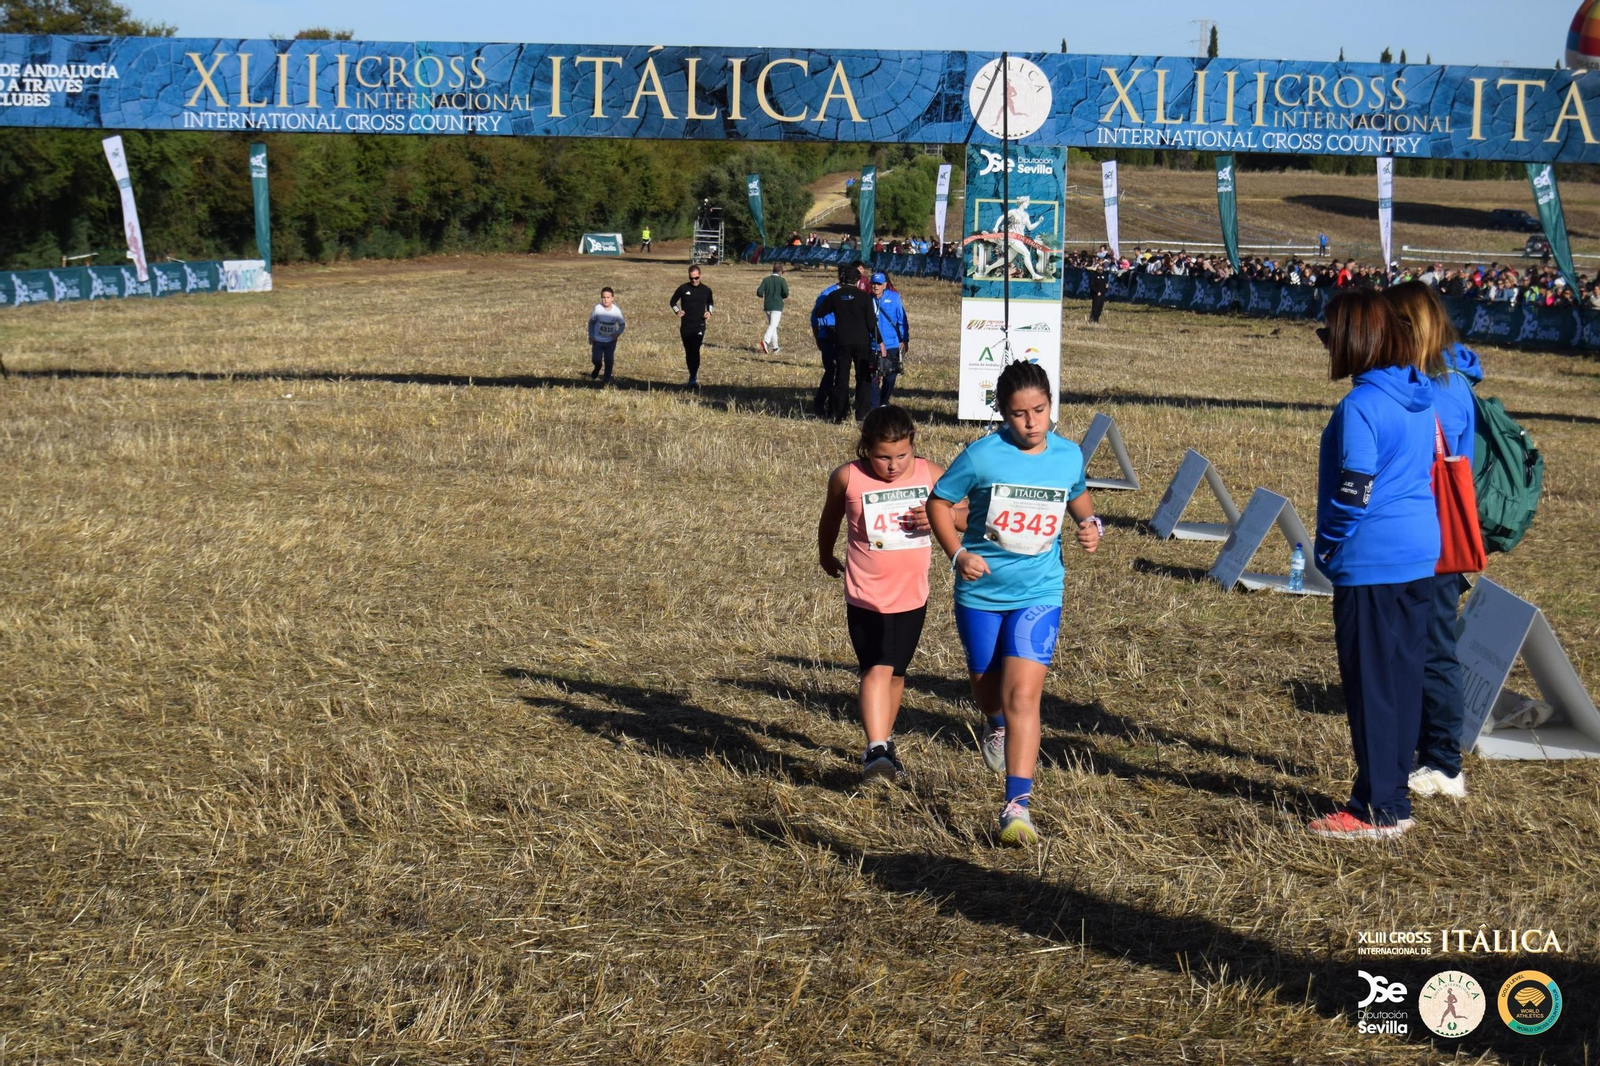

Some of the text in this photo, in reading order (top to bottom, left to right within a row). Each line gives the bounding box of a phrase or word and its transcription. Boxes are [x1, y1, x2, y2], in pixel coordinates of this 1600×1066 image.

[0, 62, 119, 79] DE ANDALUCÍA
[184, 52, 351, 109] XLIII
[355, 55, 486, 89] CROSS
[7, 79, 20, 92] A
[547, 45, 867, 123] ITÁLICA
[1274, 73, 1408, 110] CROSS
[356, 92, 534, 111] INTERNACIONAL
[1098, 67, 1269, 127] XLIII
[1467, 69, 1600, 145] ITÁ
[183, 111, 502, 133] INTERNATIONAL CROSS COUNTRY
[1273, 110, 1454, 133] INTERNACIONAL
[1097, 127, 1421, 153] INTERNATIONAL CROSS COUNTRY
[1018, 156, 1053, 165] Diputación
[1018, 164, 1053, 175] Sevilla
[1014, 487, 1048, 499] ITÁLICA
[993, 510, 1058, 537] 4343
